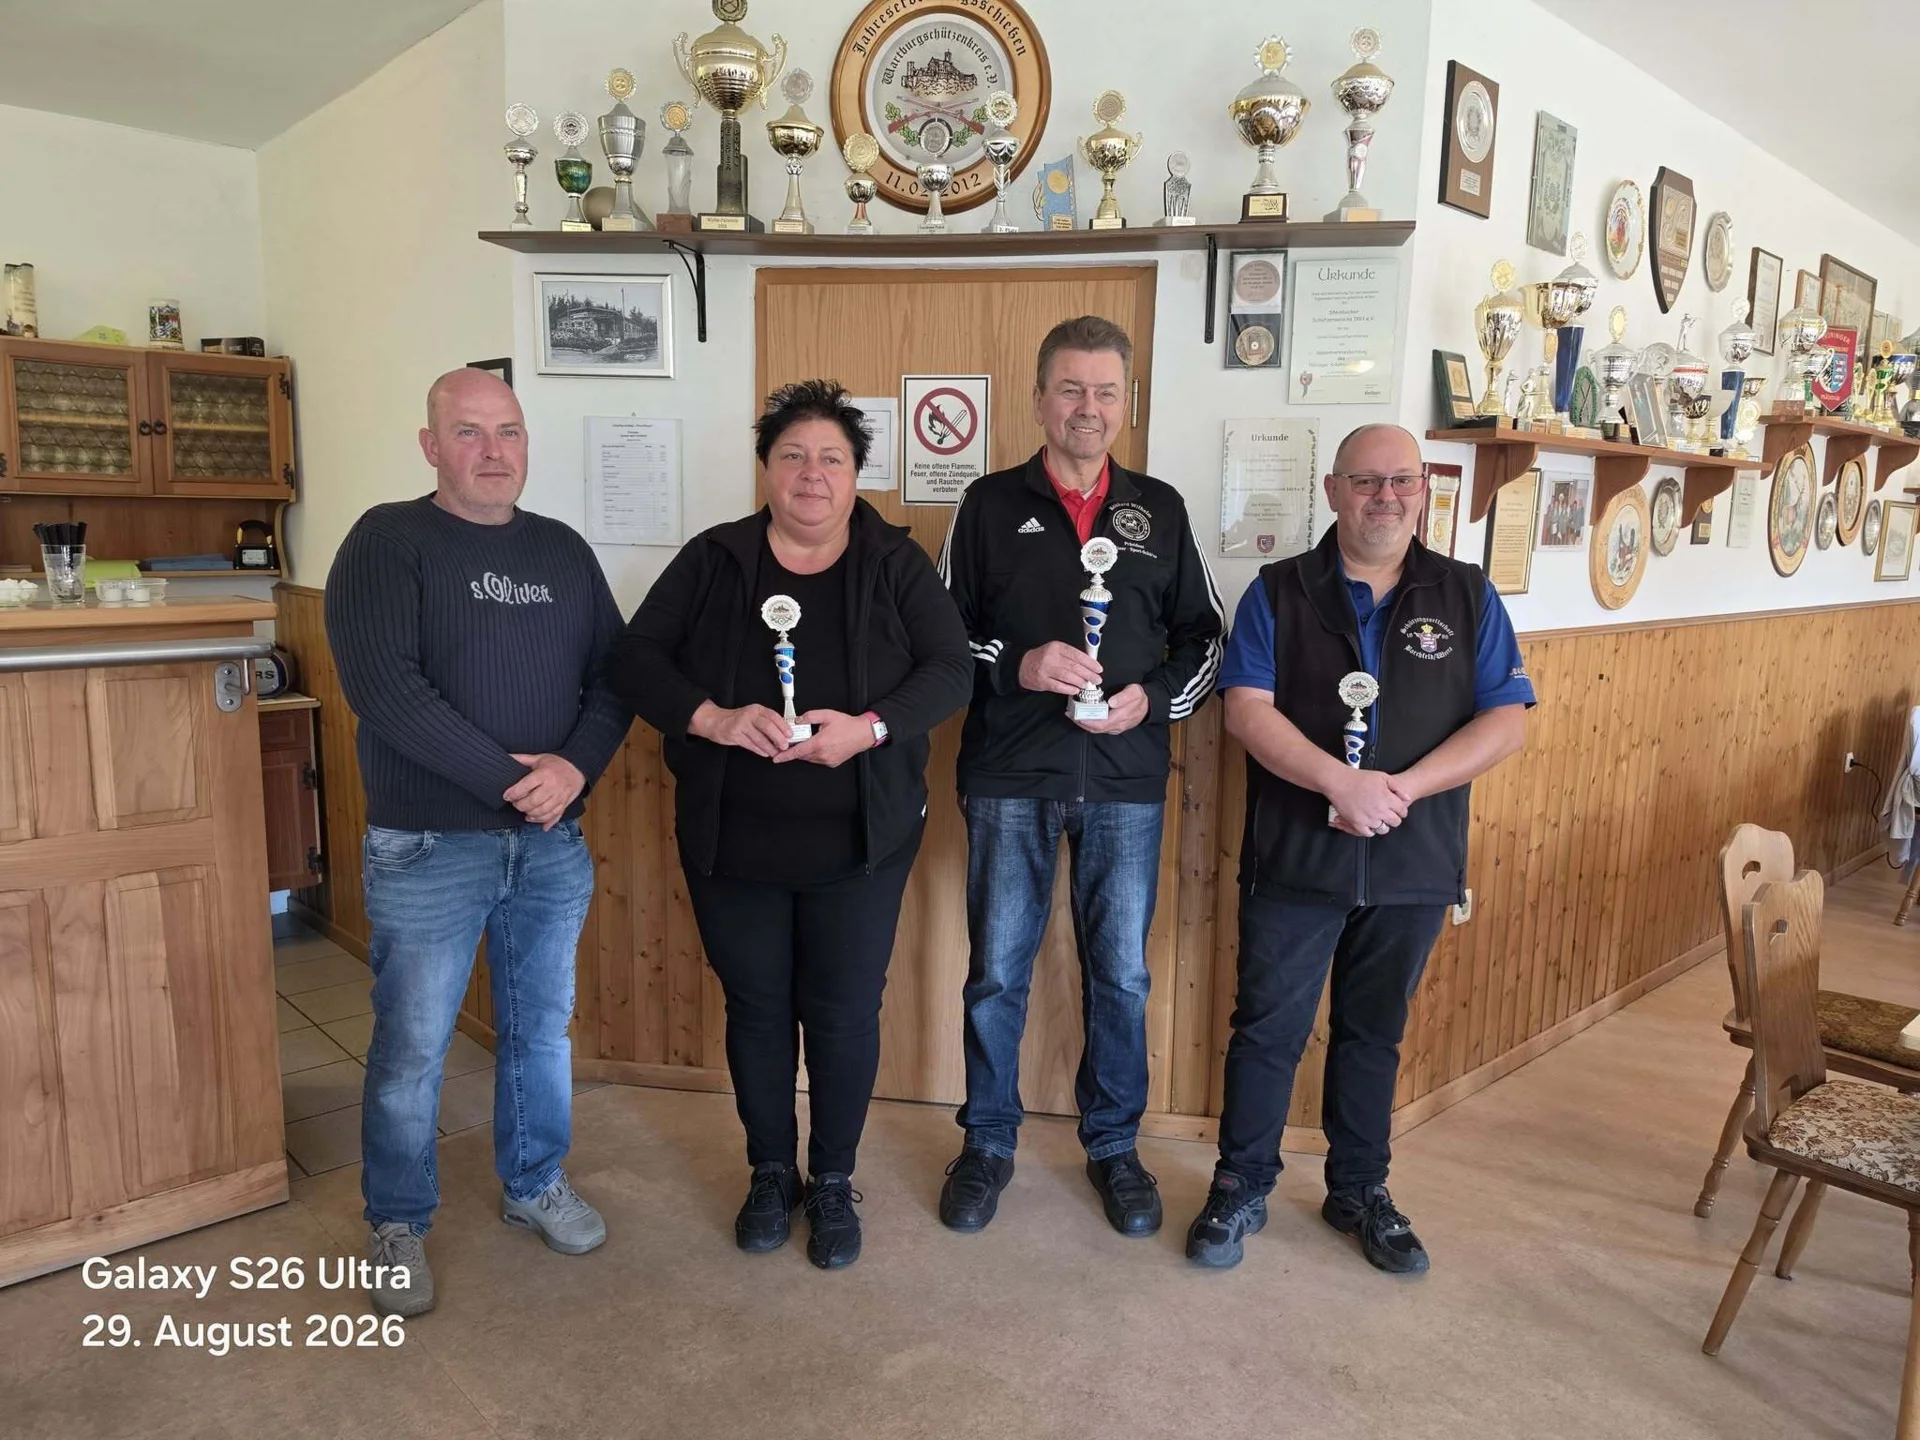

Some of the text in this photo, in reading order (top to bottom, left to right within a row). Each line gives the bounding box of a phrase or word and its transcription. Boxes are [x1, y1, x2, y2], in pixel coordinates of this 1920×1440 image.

[1252, 434, 1290, 442] Urkunde
[914, 462, 930, 470] Keine
[931, 462, 950, 470] offene
[910, 470, 981, 478] Feuer, offene Zündquelle
[926, 478, 964, 486] und Rauchen
[1018, 526, 1045, 534] adidas
[470, 571, 553, 605] s.Oliver
